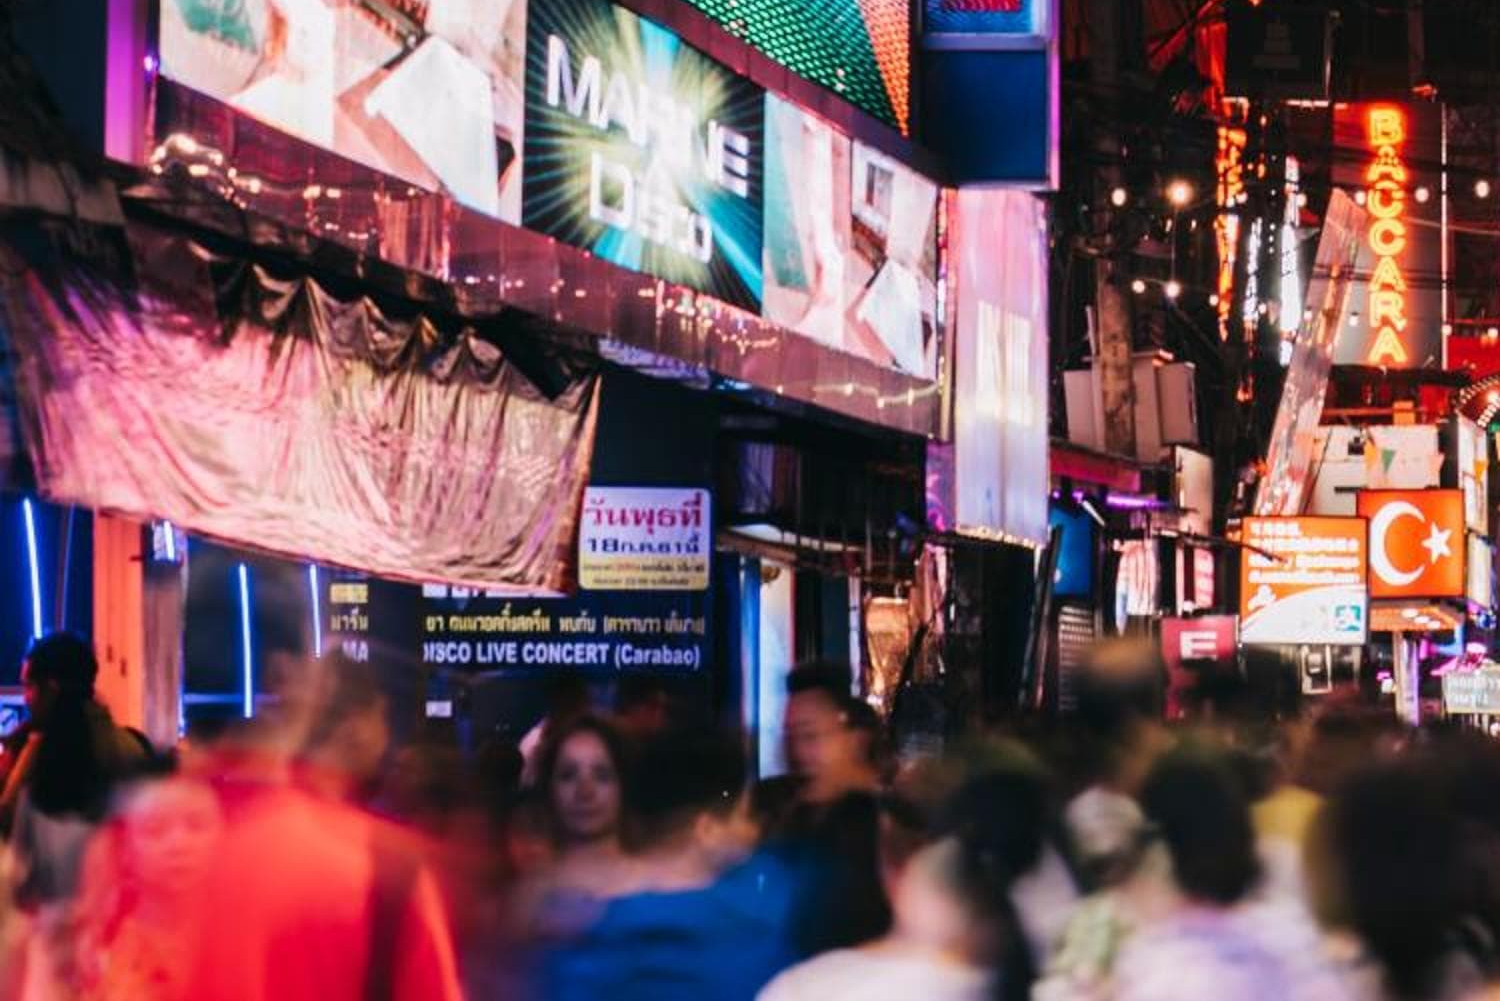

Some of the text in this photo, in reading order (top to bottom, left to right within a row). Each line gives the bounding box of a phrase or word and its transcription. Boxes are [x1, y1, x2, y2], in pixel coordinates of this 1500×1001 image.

[547, 34, 750, 199] MARNE
[1366, 109, 1407, 363] BACCARA
[476, 641, 518, 664] LIVE
[522, 642, 609, 665] CONCERT
[614, 643, 701, 669] (Carabao)
